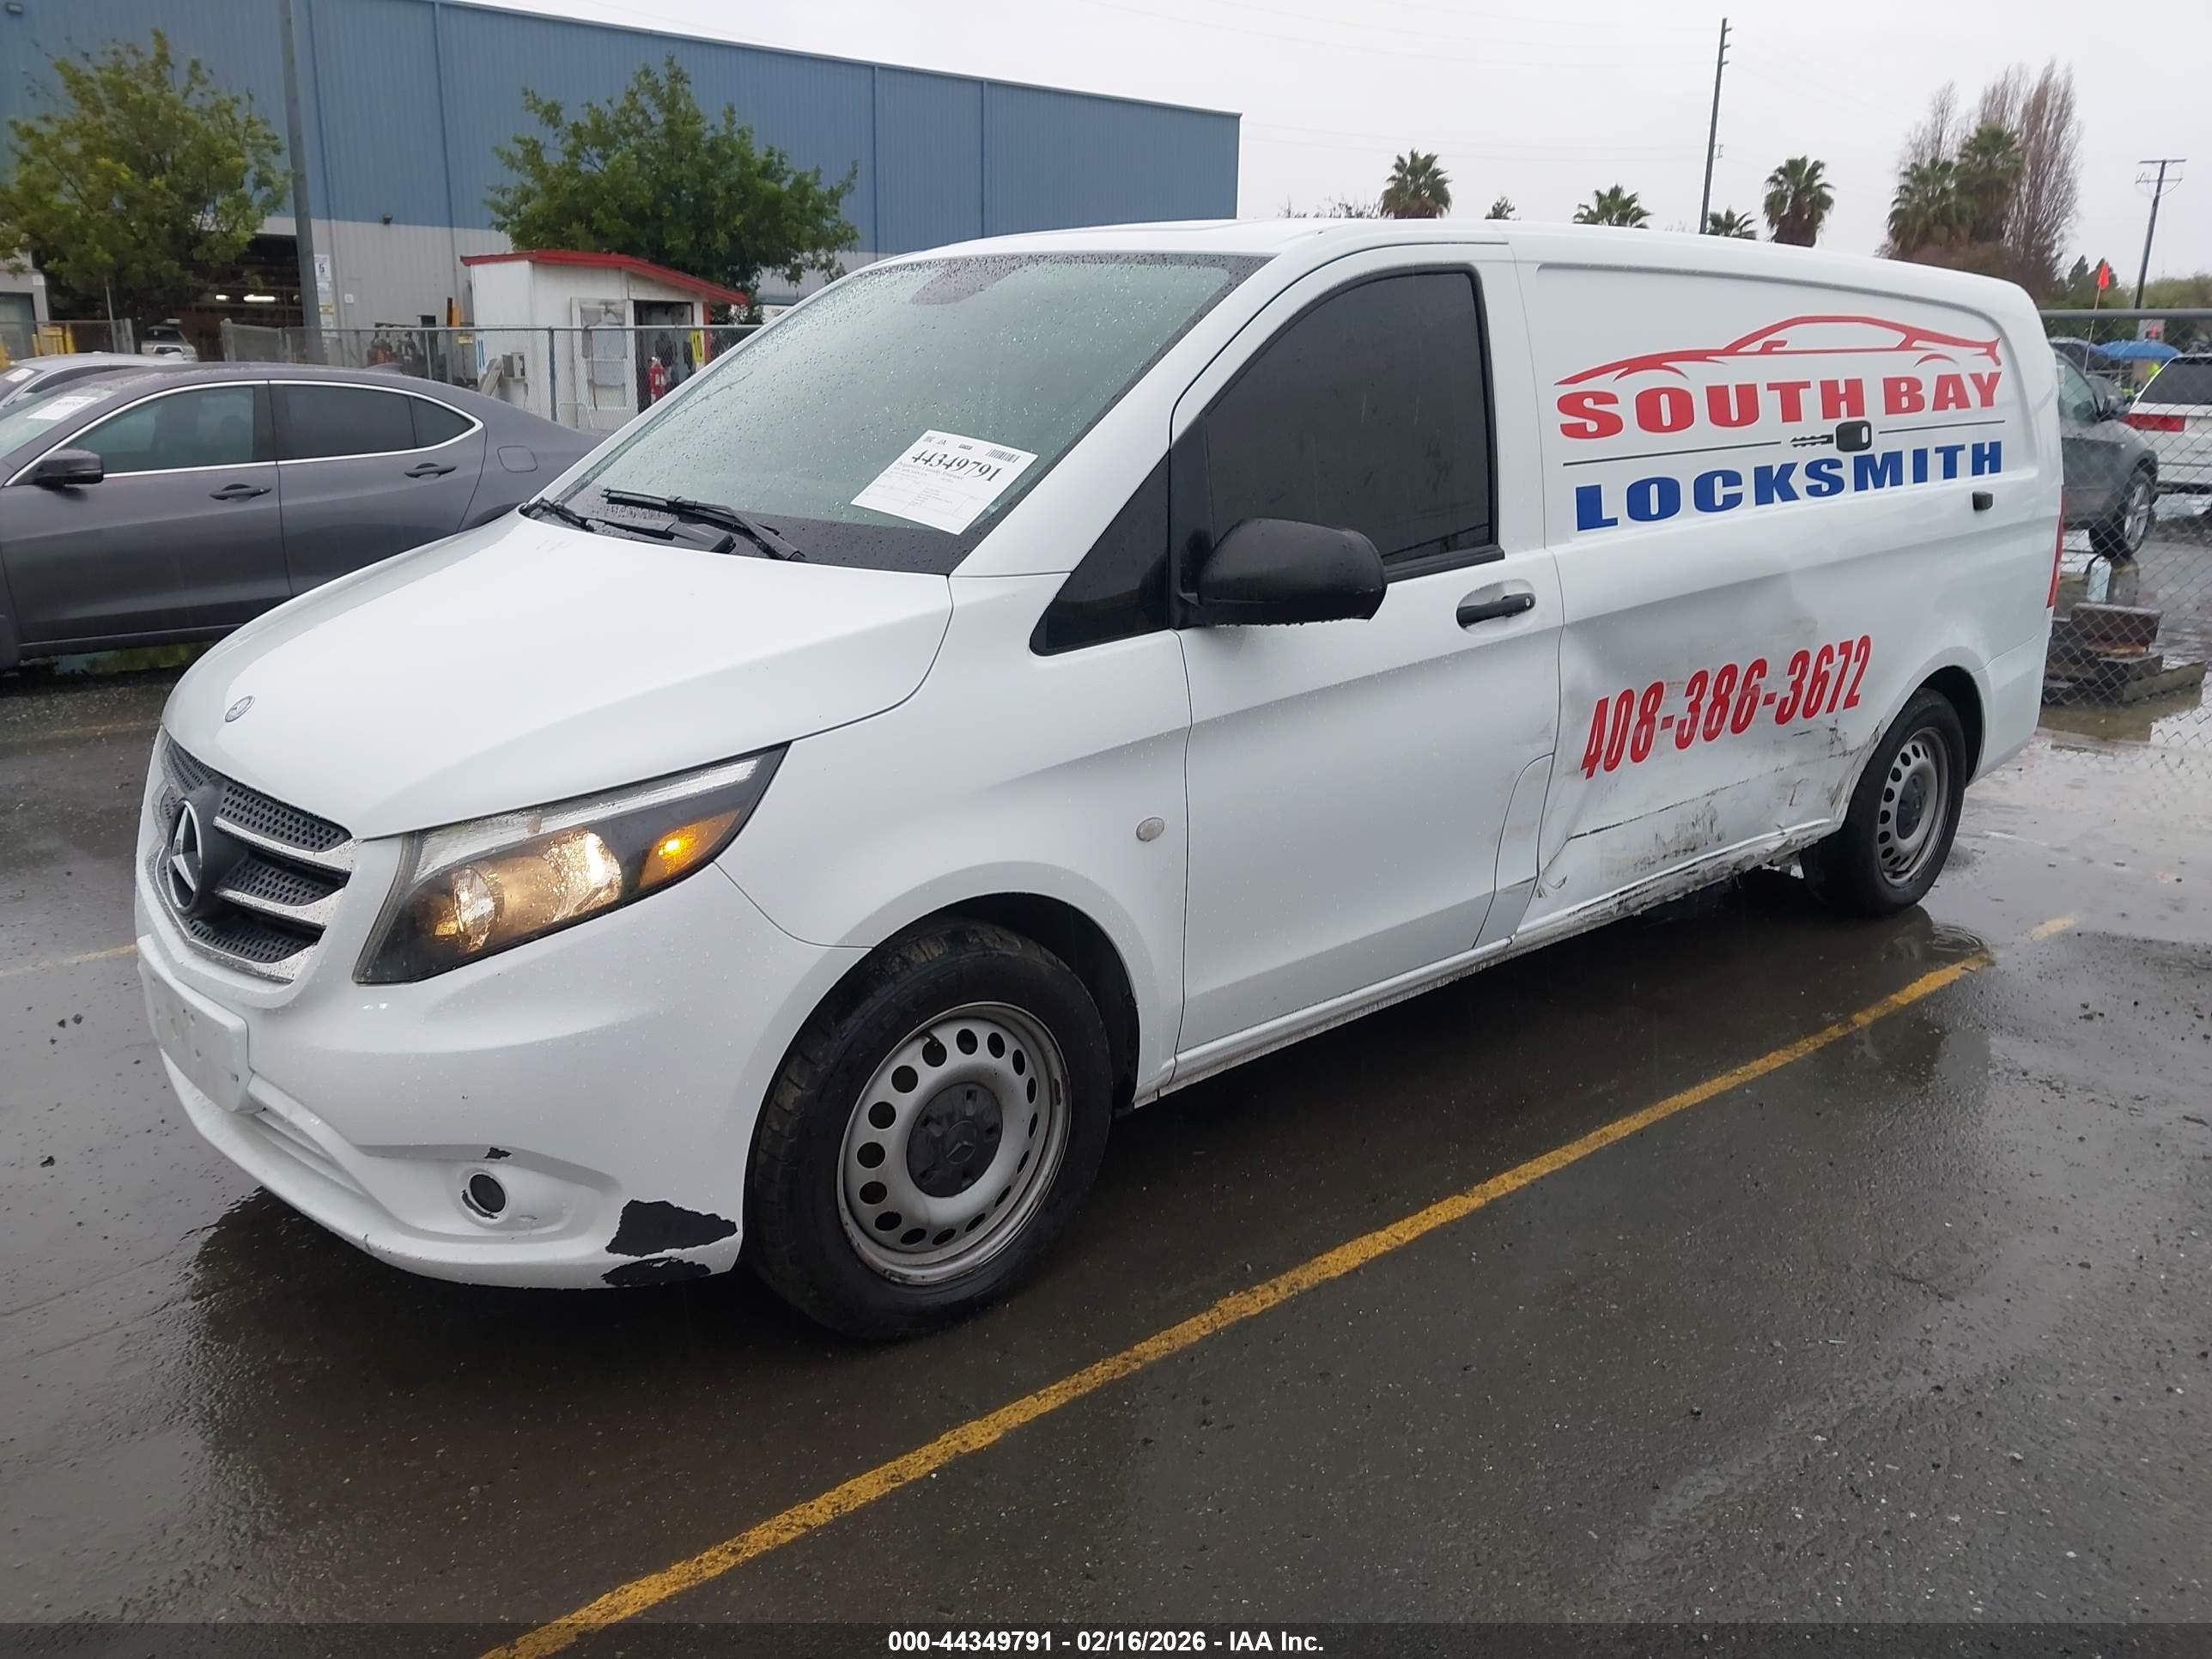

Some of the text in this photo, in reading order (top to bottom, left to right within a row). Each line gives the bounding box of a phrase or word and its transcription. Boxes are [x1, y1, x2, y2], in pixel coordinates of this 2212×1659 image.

[1556, 372, 2001, 440] SOUTH BAY
[911, 449, 1002, 481] 44349791
[1575, 441, 2002, 532] LOCKSMITH
[1581, 635, 1872, 780] 408-386-3672
